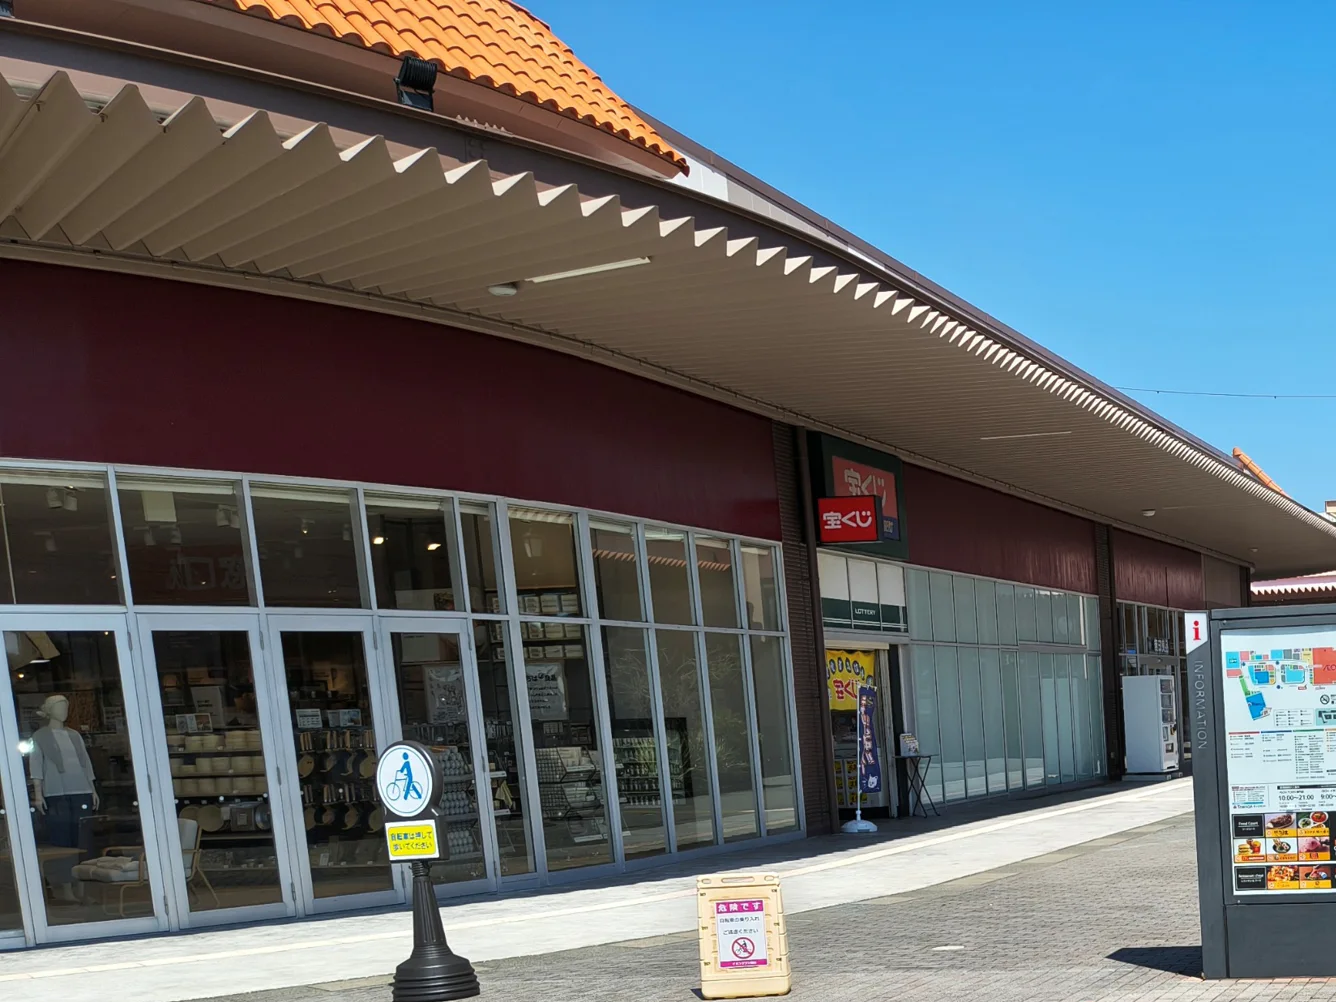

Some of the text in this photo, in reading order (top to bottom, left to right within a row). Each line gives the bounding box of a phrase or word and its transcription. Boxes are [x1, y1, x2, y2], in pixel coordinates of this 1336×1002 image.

[822, 511, 873, 530] 宝くじ
[854, 607, 876, 616] LOTTERY
[1194, 660, 1208, 749] INFORMATION
[718, 902, 761, 912] 危険です
